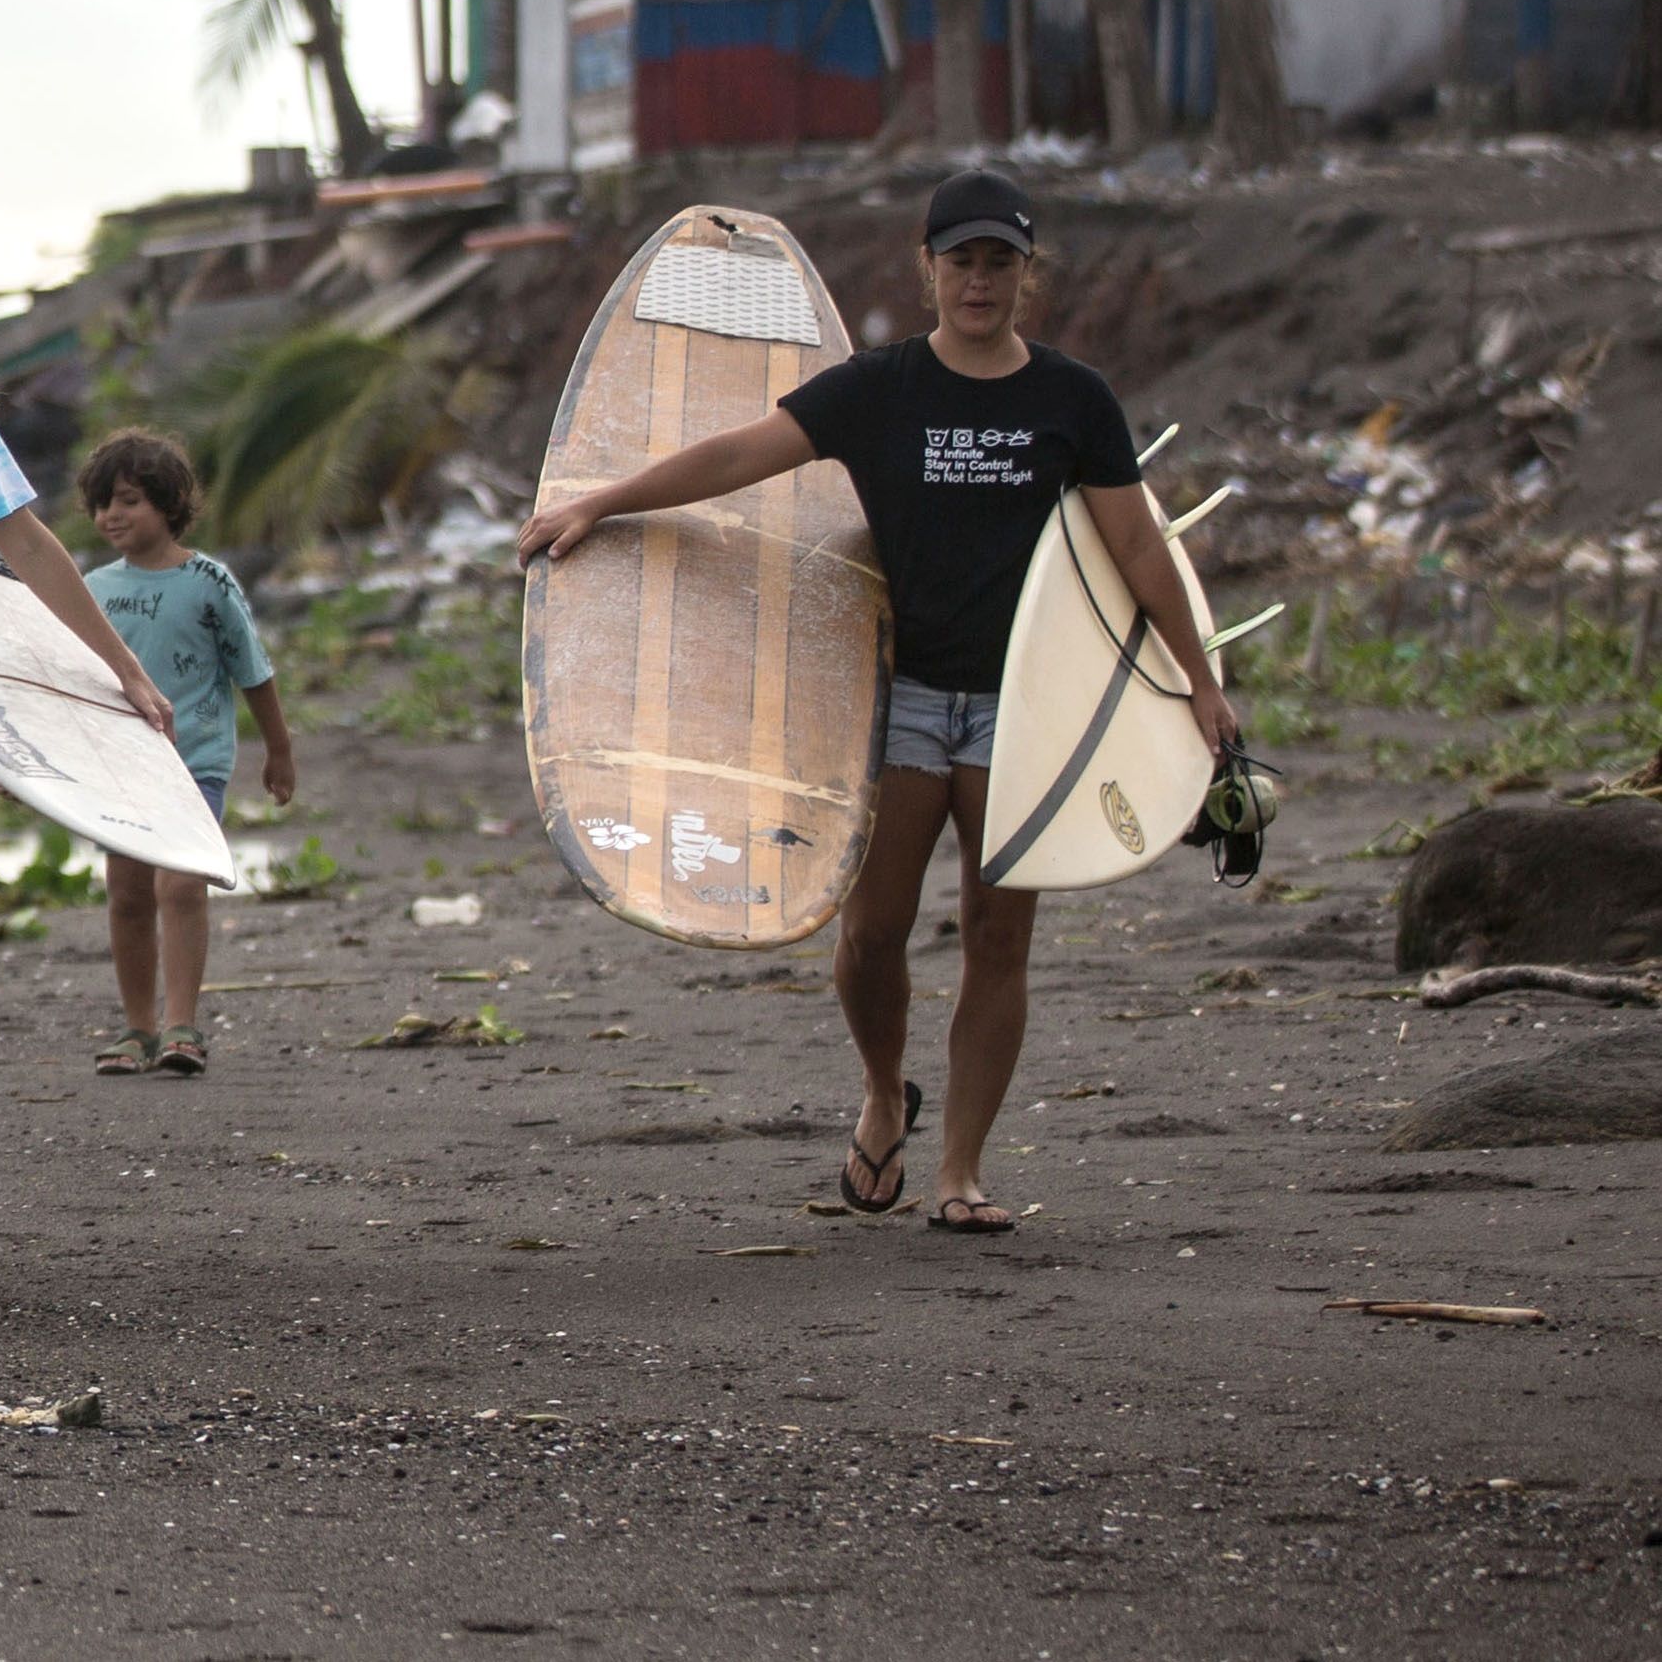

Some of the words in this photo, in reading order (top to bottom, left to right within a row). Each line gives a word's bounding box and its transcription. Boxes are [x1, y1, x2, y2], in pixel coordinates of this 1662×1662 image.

[925, 448, 941, 458] Be
[944, 449, 984, 459] Infinite
[925, 459, 952, 472] Stay
[969, 459, 1013, 471] Control
[924, 472, 940, 482] Do
[944, 472, 965, 483] Not
[968, 473, 997, 483] Lose
[1001, 470, 1032, 486] Sight
